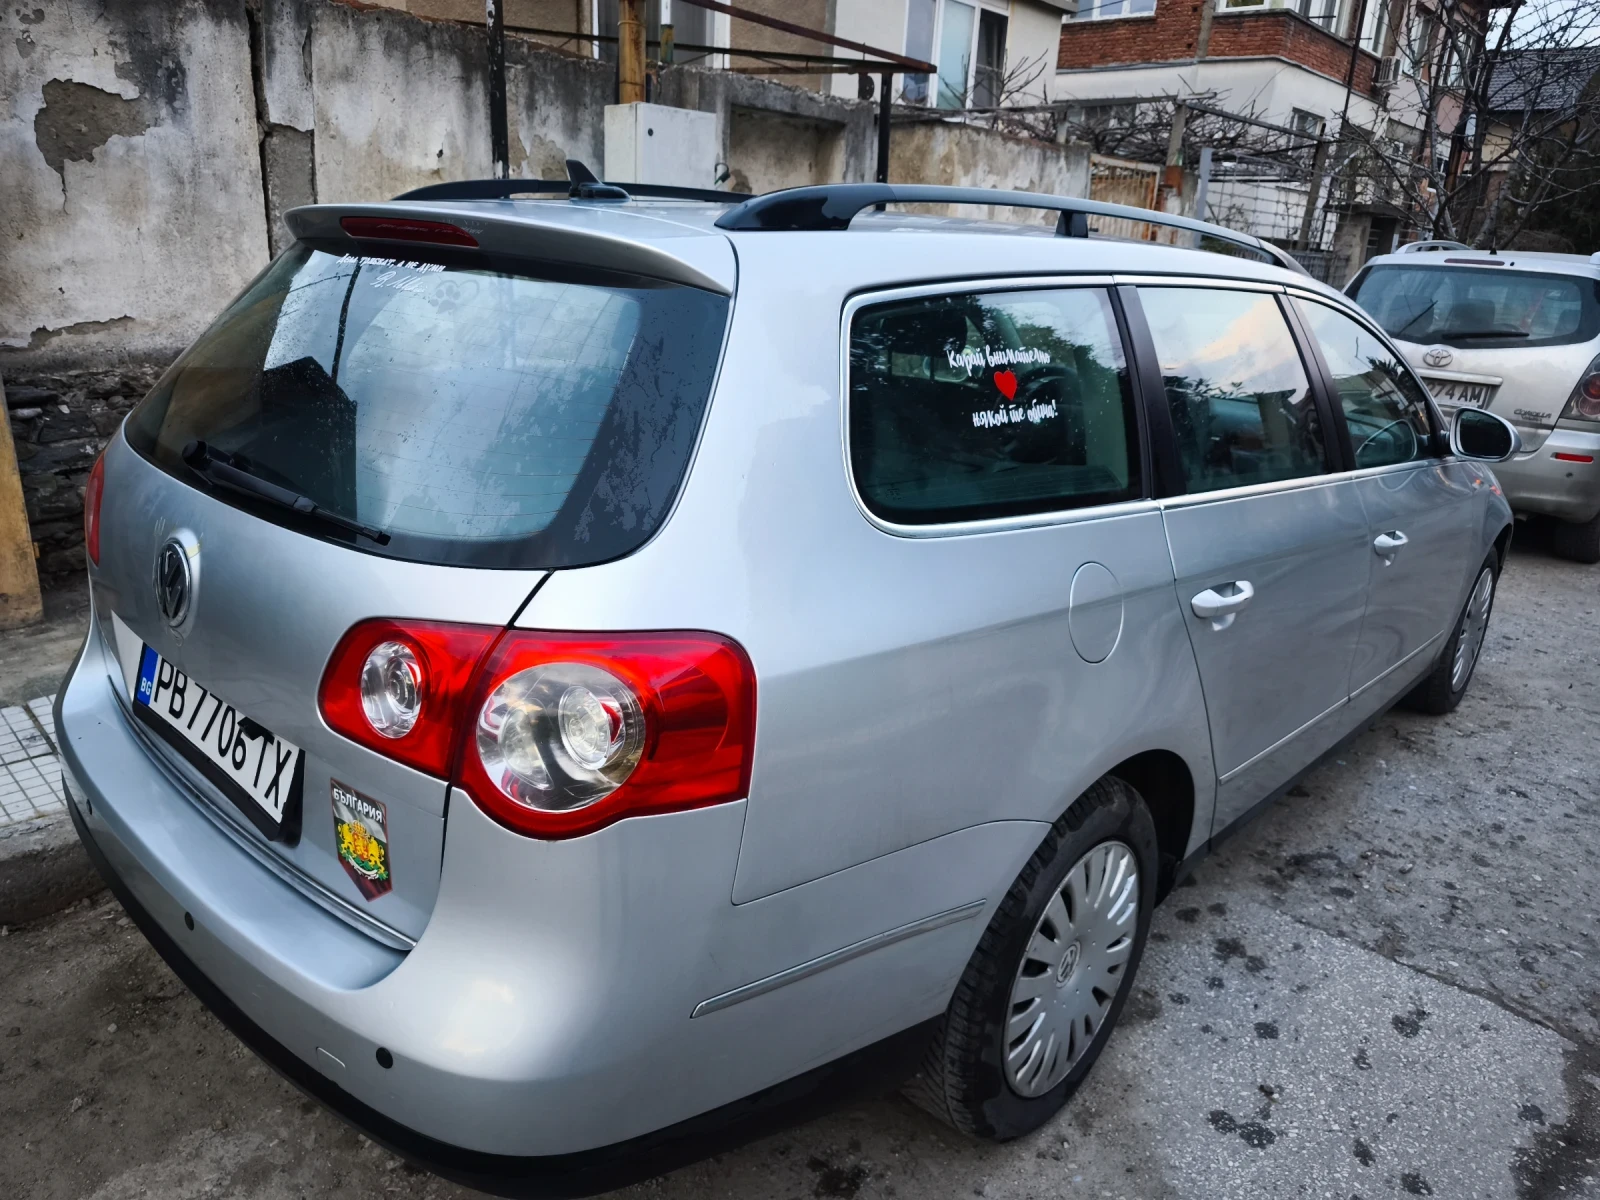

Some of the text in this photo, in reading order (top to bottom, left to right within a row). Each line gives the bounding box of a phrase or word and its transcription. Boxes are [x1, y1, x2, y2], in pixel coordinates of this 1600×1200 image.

[946, 347, 986, 377] Карай
[1457, 385, 1484, 404] AM
[972, 404, 1008, 428] някой
[1027, 398, 1059, 424] обича!
[140, 677, 152, 696] BG
[154, 657, 292, 809] PB 7706 TX
[333, 787, 383, 823] БЪЛГАРИЯ
